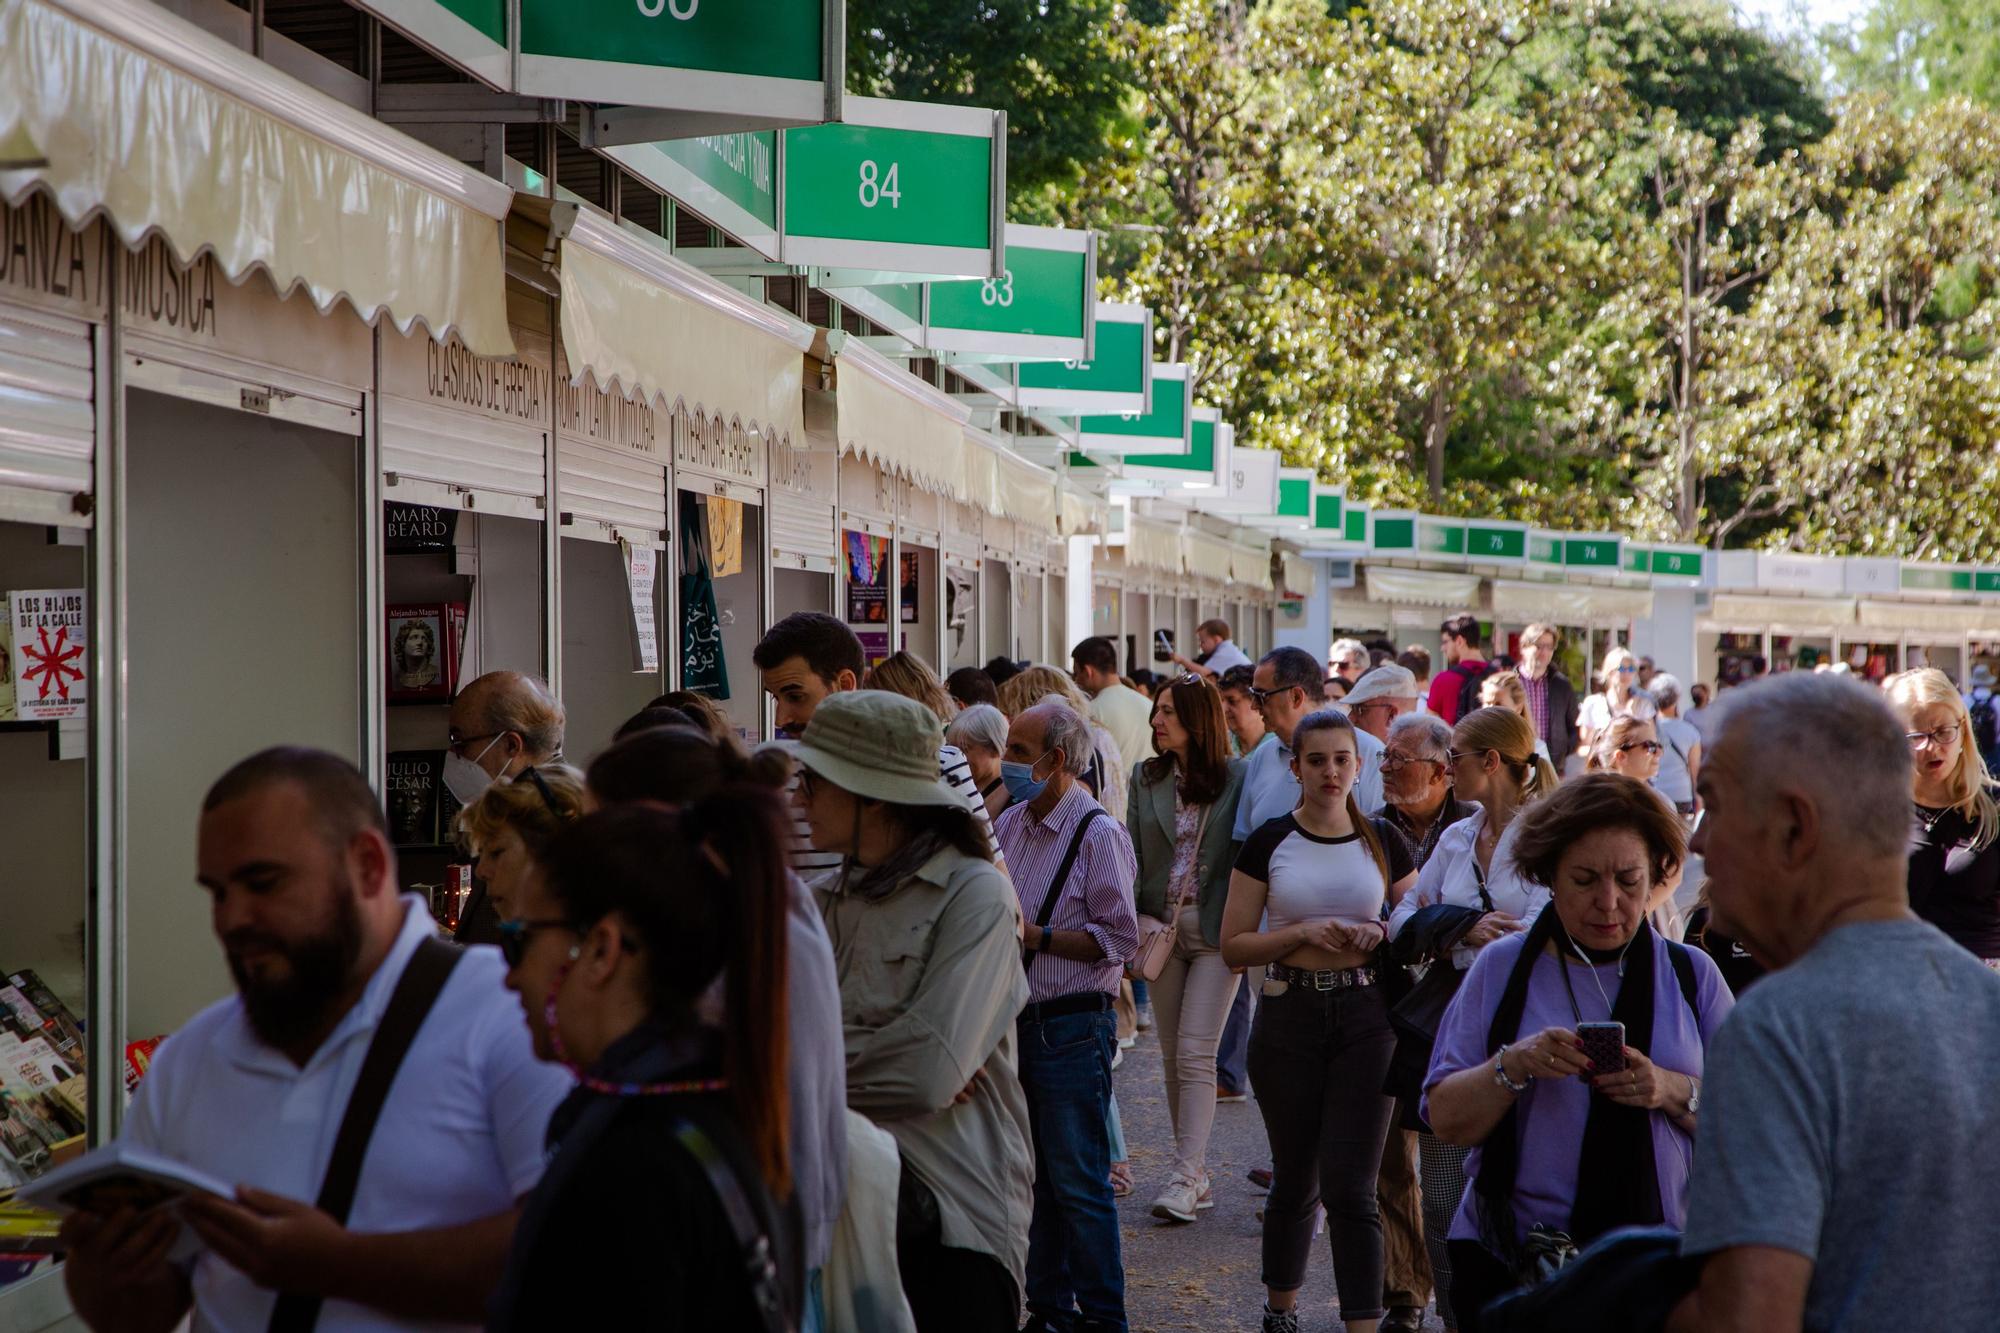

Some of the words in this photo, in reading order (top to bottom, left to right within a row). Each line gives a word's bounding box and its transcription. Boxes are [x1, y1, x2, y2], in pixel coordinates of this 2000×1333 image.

[859, 160, 902, 210] 84
[0, 191, 88, 303] ANZA
[981, 269, 1014, 307] 83
[503, 360, 541, 422] GRECIA
[541, 368, 550, 423] Y
[1233, 469, 1245, 490] 9
[392, 507, 442, 522] MARY
[387, 521, 448, 537] BEARD
[18, 597, 40, 613] LOS
[45, 596, 82, 612] HIJOS
[20, 615, 32, 628] DE
[36, 613, 49, 627] LA
[52, 612, 82, 627] CALLE
[386, 761, 431, 777] JULIO
